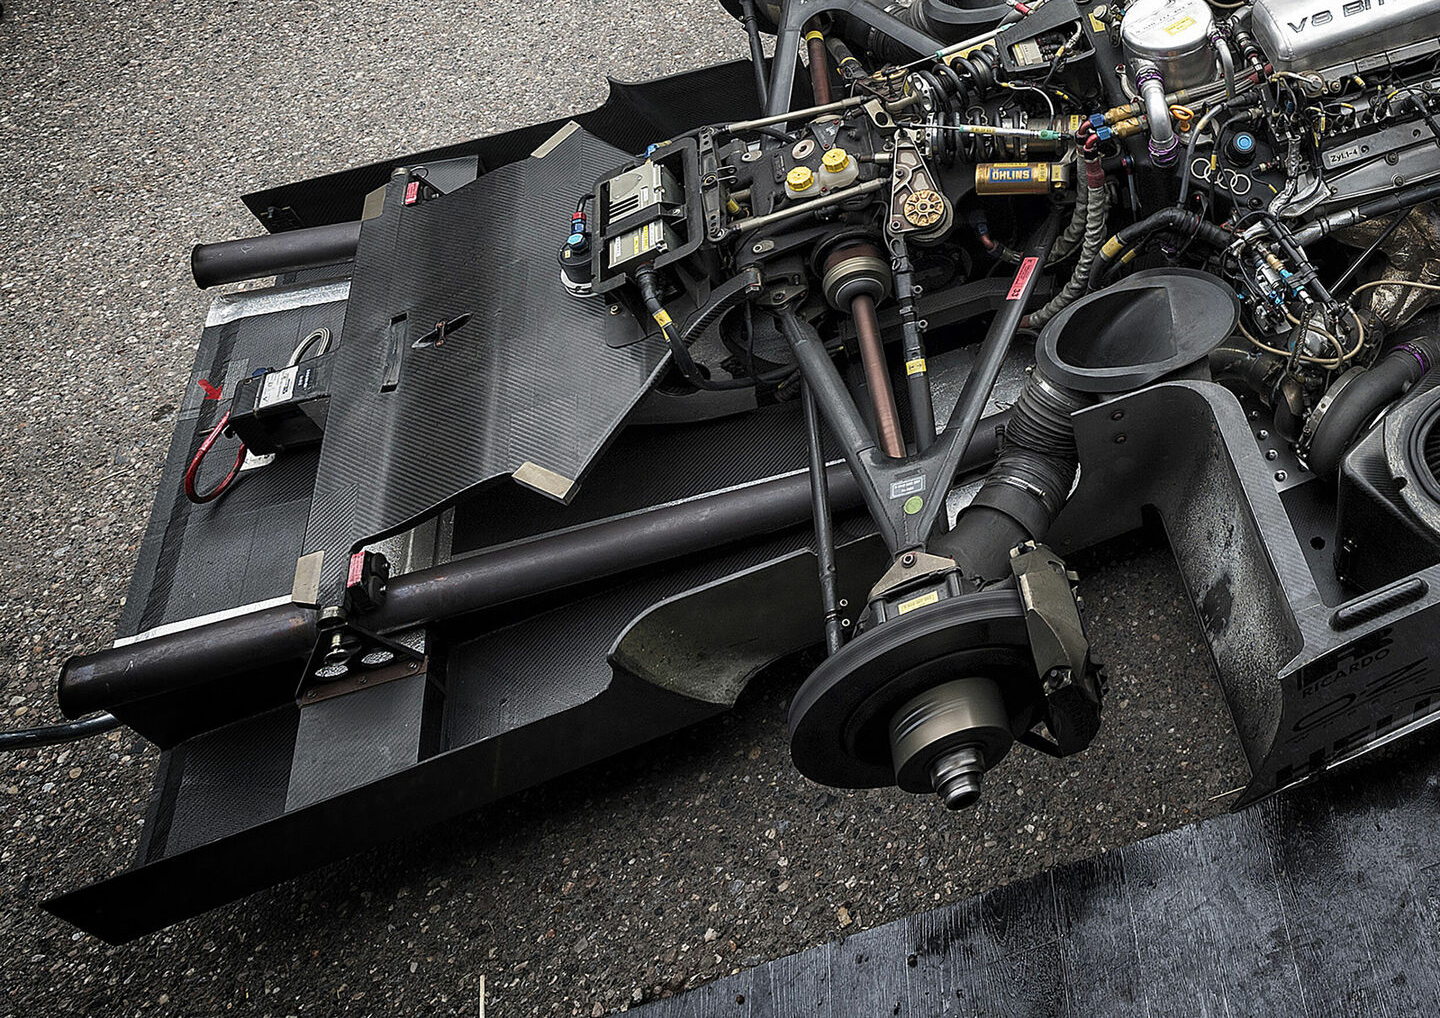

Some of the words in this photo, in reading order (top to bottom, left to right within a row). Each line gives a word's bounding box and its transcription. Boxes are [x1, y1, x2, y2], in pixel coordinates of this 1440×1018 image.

[1287, 10, 1333, 33] V8
[992, 168, 1030, 180] ÖHLINS
[1302, 648, 1390, 699] RICARDO
